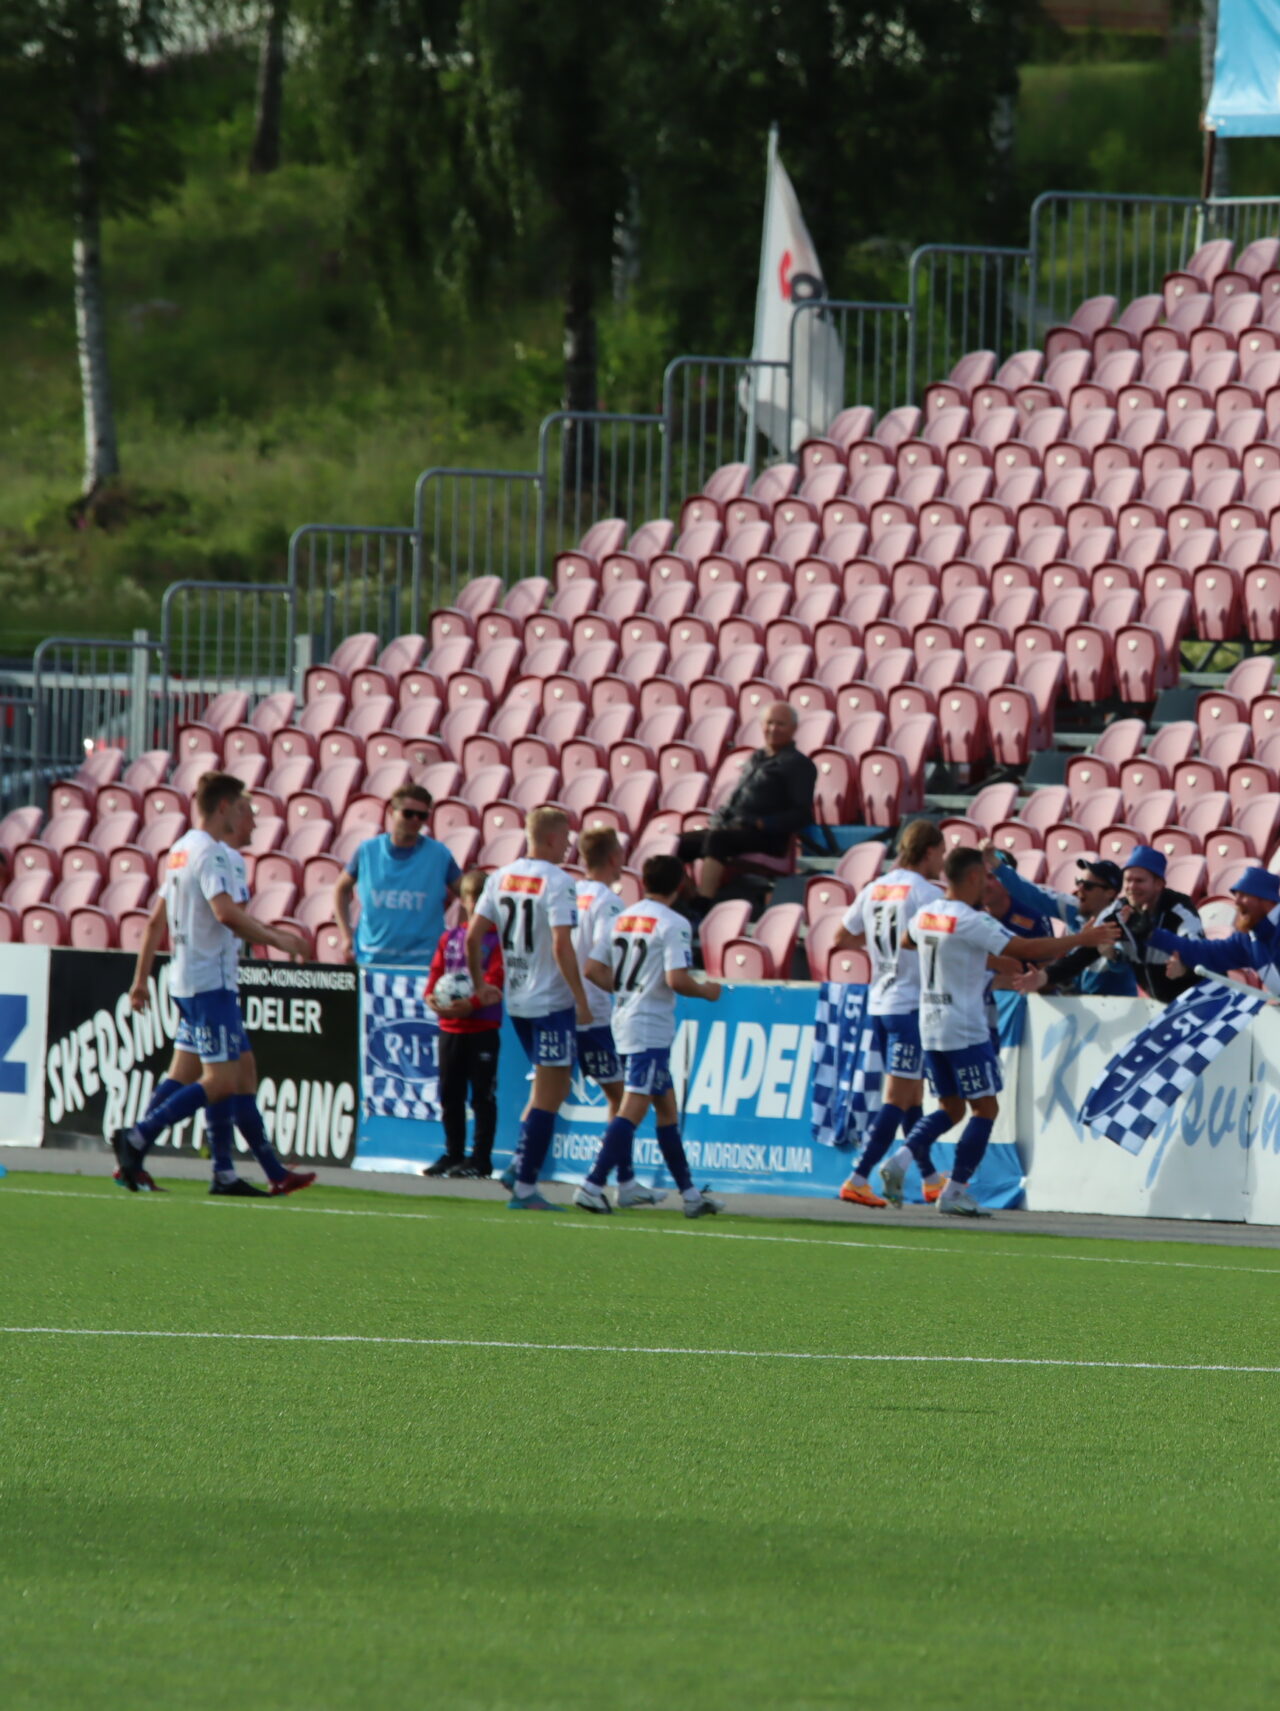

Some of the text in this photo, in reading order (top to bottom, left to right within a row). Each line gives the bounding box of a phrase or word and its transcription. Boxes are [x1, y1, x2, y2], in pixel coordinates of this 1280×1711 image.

[370, 888, 426, 911] VERT
[500, 896, 534, 954] 21
[613, 937, 649, 993] 22
[924, 936, 939, 992] 7
